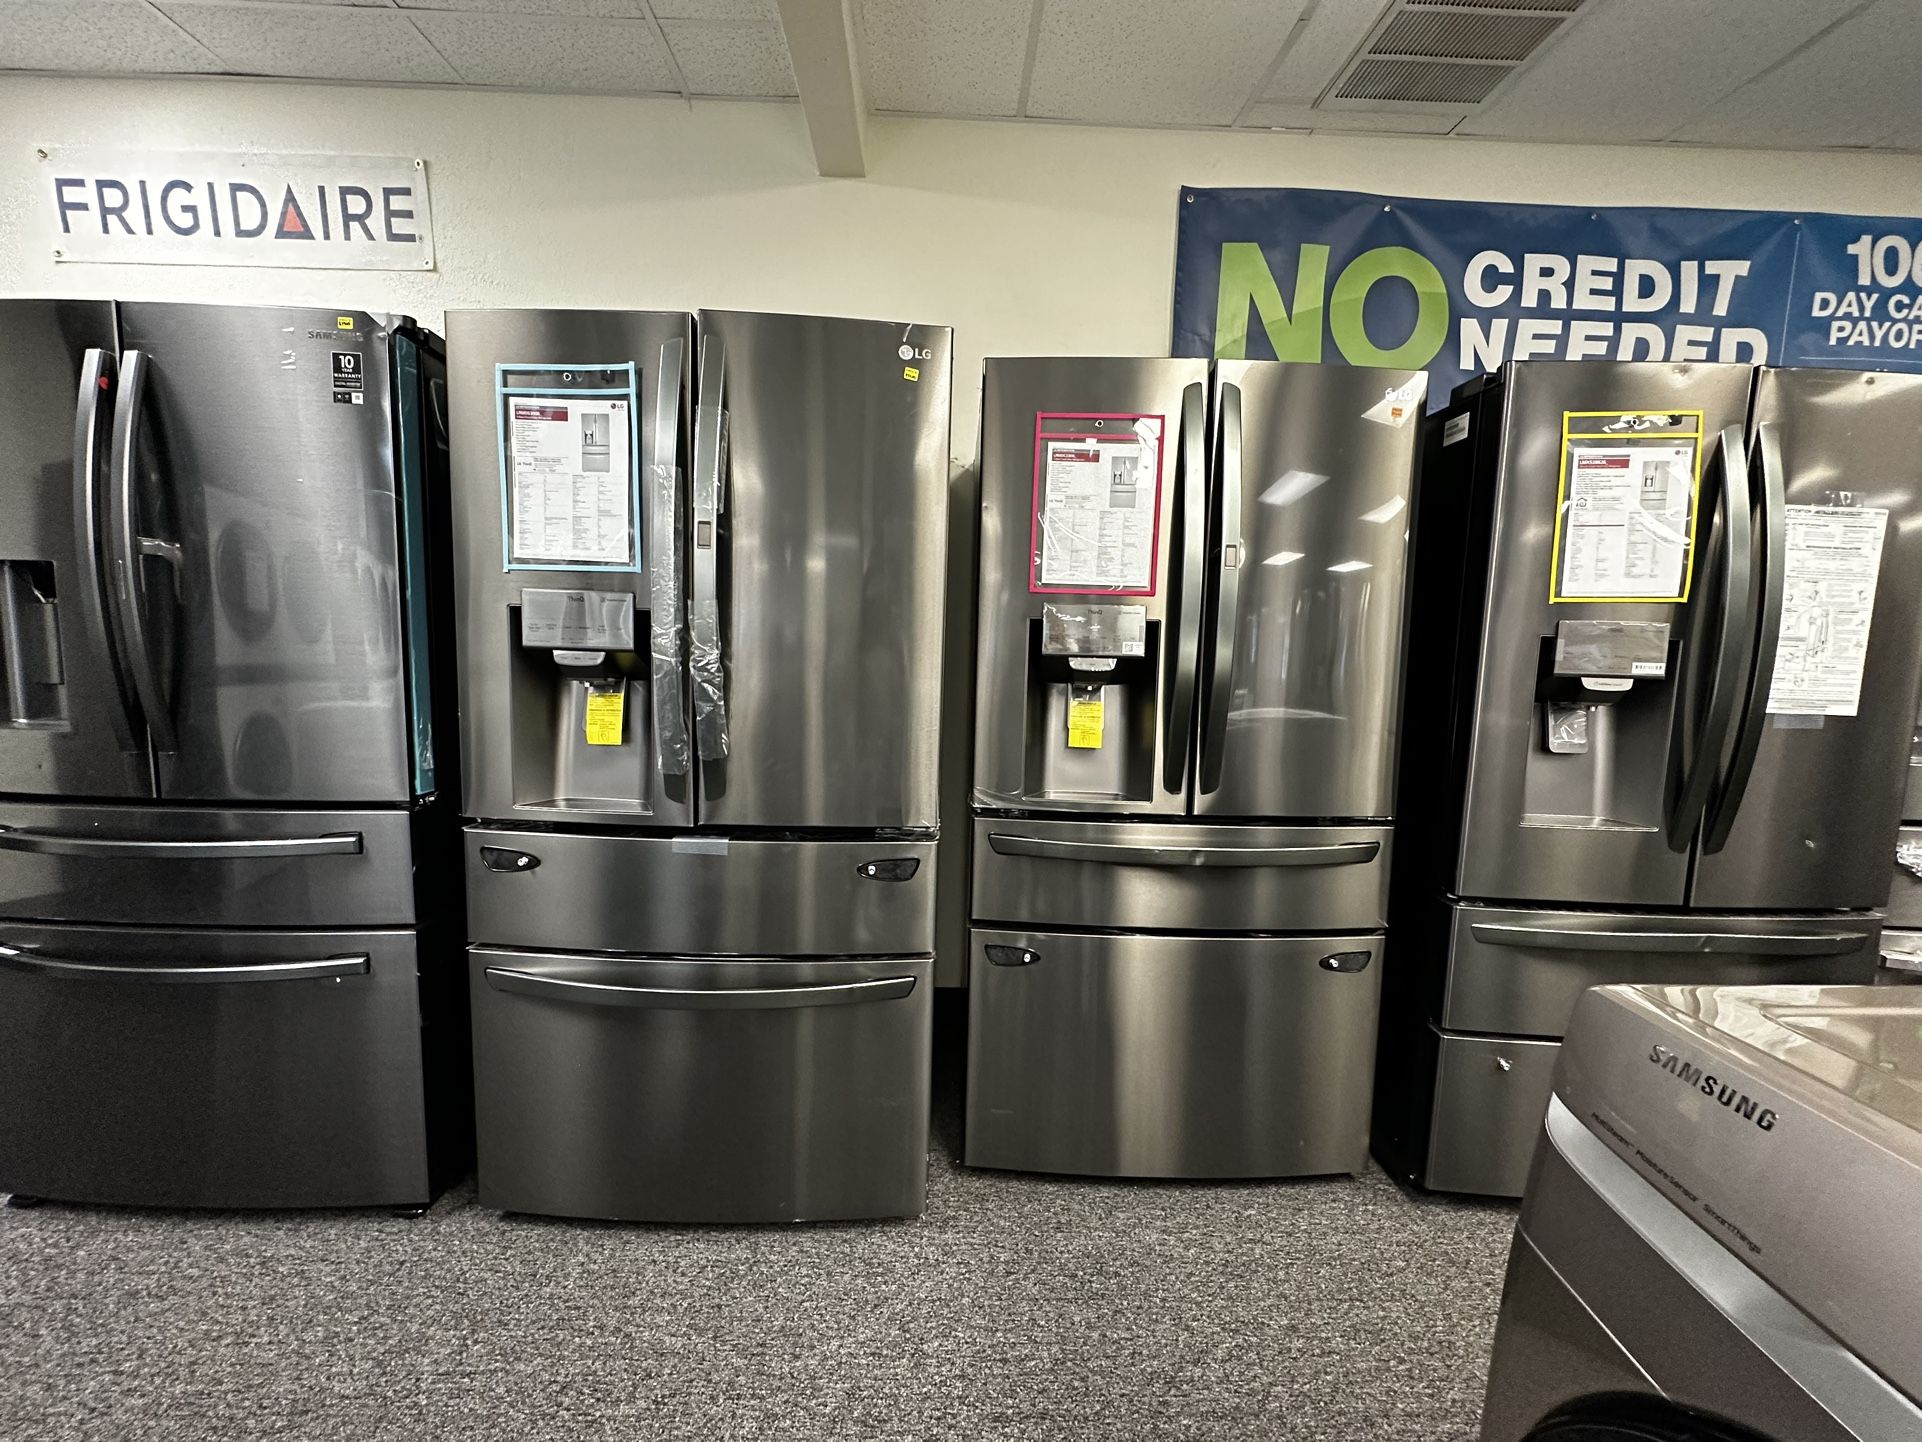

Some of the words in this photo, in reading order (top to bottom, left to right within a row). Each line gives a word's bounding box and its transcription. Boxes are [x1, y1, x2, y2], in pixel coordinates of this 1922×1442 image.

[54, 177, 418, 243] FRIGIDAIRE
[1462, 250, 1752, 317] CREDIT
[1846, 234, 1922, 288] 10
[1213, 241, 1450, 371] NO
[1811, 291, 1880, 318] DAY
[338, 355, 354, 368] 10
[915, 348, 931, 359] LG
[1458, 317, 1769, 374] NEEDED
[1649, 1044, 1778, 1132] SAMSUNG
